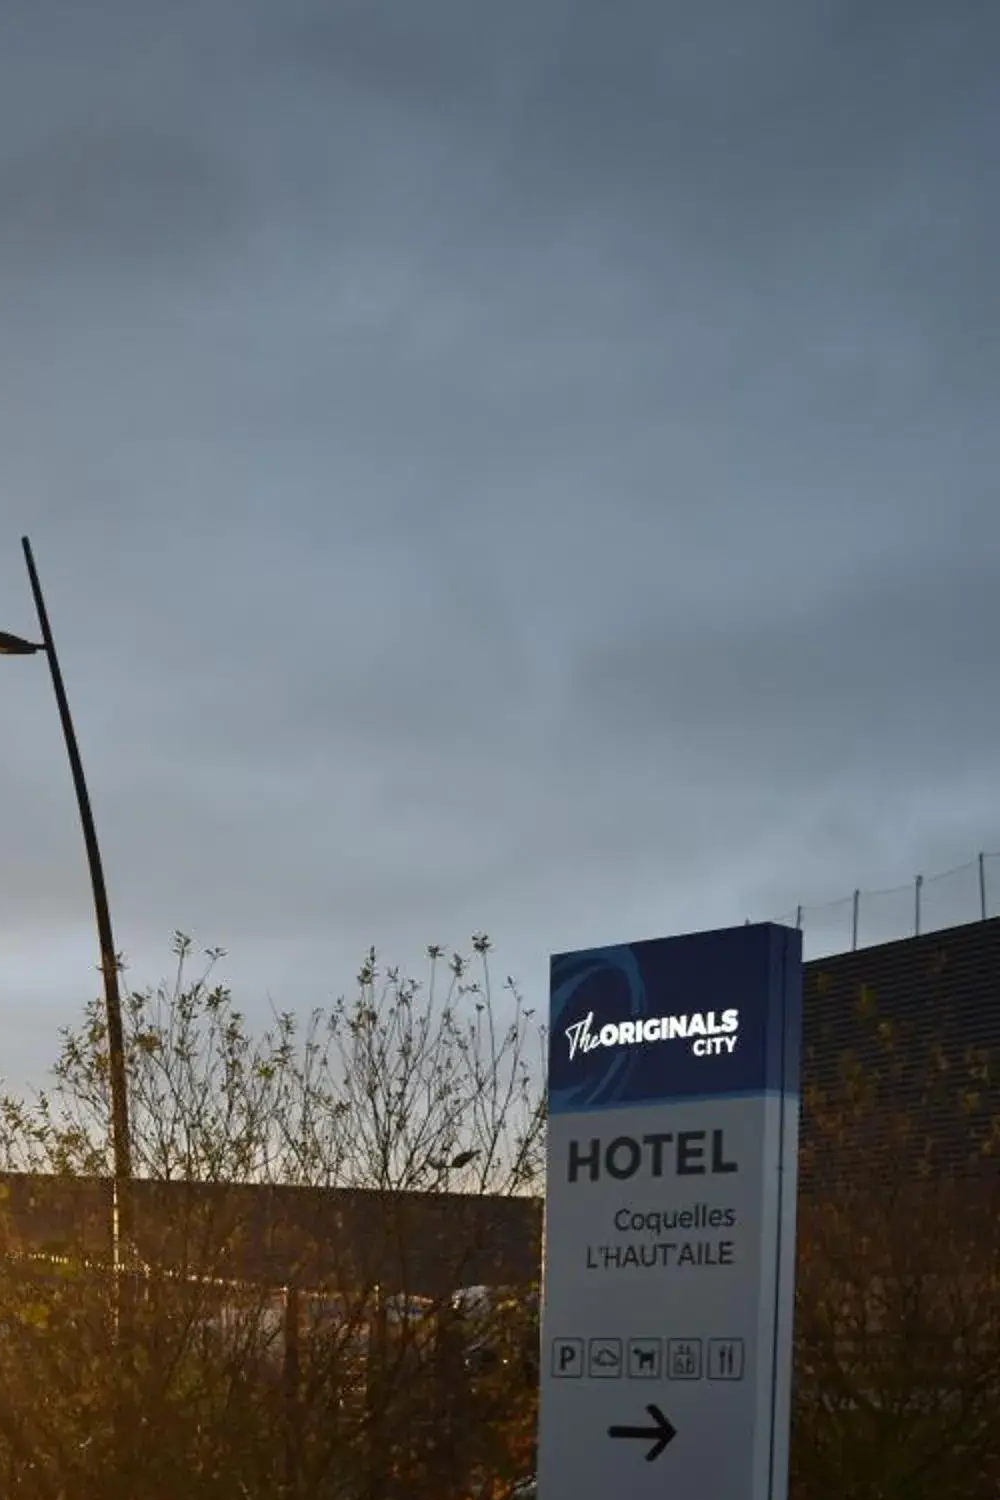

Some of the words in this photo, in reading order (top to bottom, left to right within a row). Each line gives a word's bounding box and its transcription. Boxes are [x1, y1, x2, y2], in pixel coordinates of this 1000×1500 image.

[565, 1011, 601, 1061] The
[600, 1008, 739, 1047] ORIGINALS
[693, 1035, 738, 1057] CITY
[567, 1129, 738, 1183] HOTEL
[613, 1204, 736, 1235] Coquelles
[559, 1345, 576, 1371] P
